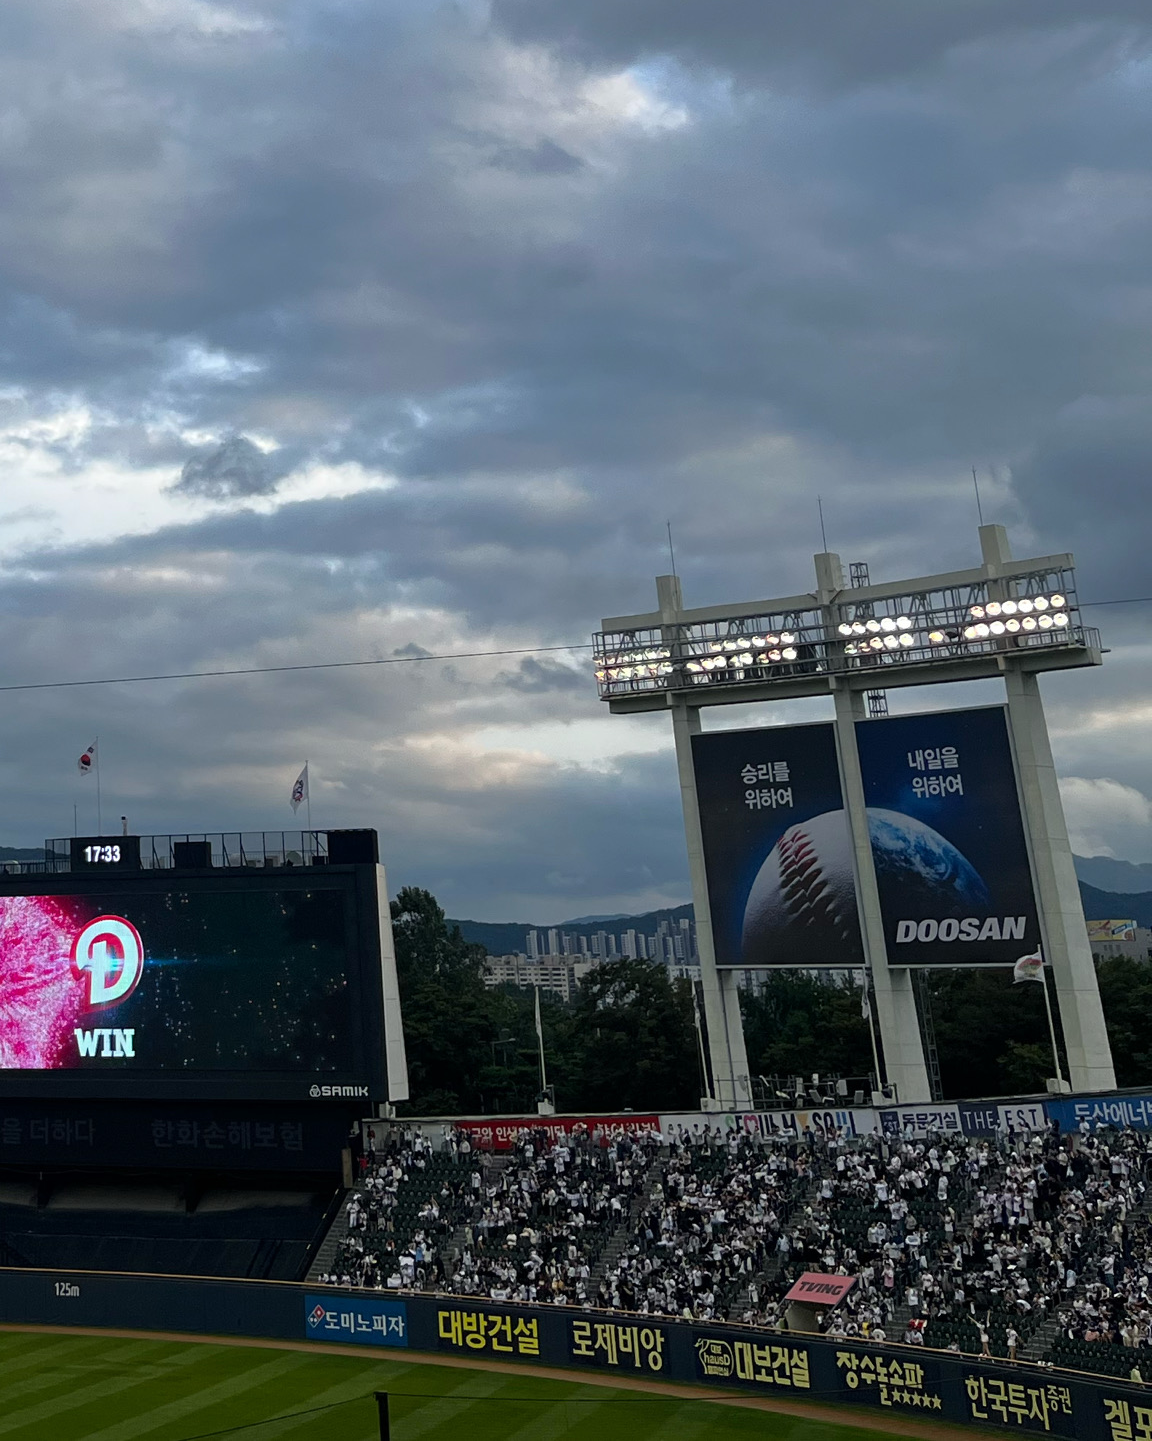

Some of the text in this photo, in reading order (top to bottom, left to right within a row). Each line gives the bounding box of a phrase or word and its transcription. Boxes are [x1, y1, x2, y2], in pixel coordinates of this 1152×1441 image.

[908, 746, 959, 771] 내일을
[740, 761, 791, 785] 승리를
[745, 787, 793, 810] 위하여
[912, 774, 963, 799] 위하여
[84, 845, 121, 863] 17:33
[895, 916, 1026, 943] DOOSAN
[74, 1028, 135, 1057] WIN
[321, 1085, 368, 1097] SAMIK
[30, 1117, 96, 1146] 더하다
[963, 1111, 995, 1130] THE
[151, 1119, 304, 1151] 한화손해보험
[54, 1282, 80, 1296] 125m
[799, 1281, 843, 1295] TVING
[324, 1311, 404, 1337] 도미노피자
[438, 1310, 540, 1355] 대방건설
[572, 1321, 664, 1371] 로제비앙
[734, 1341, 810, 1388] 대보건설
